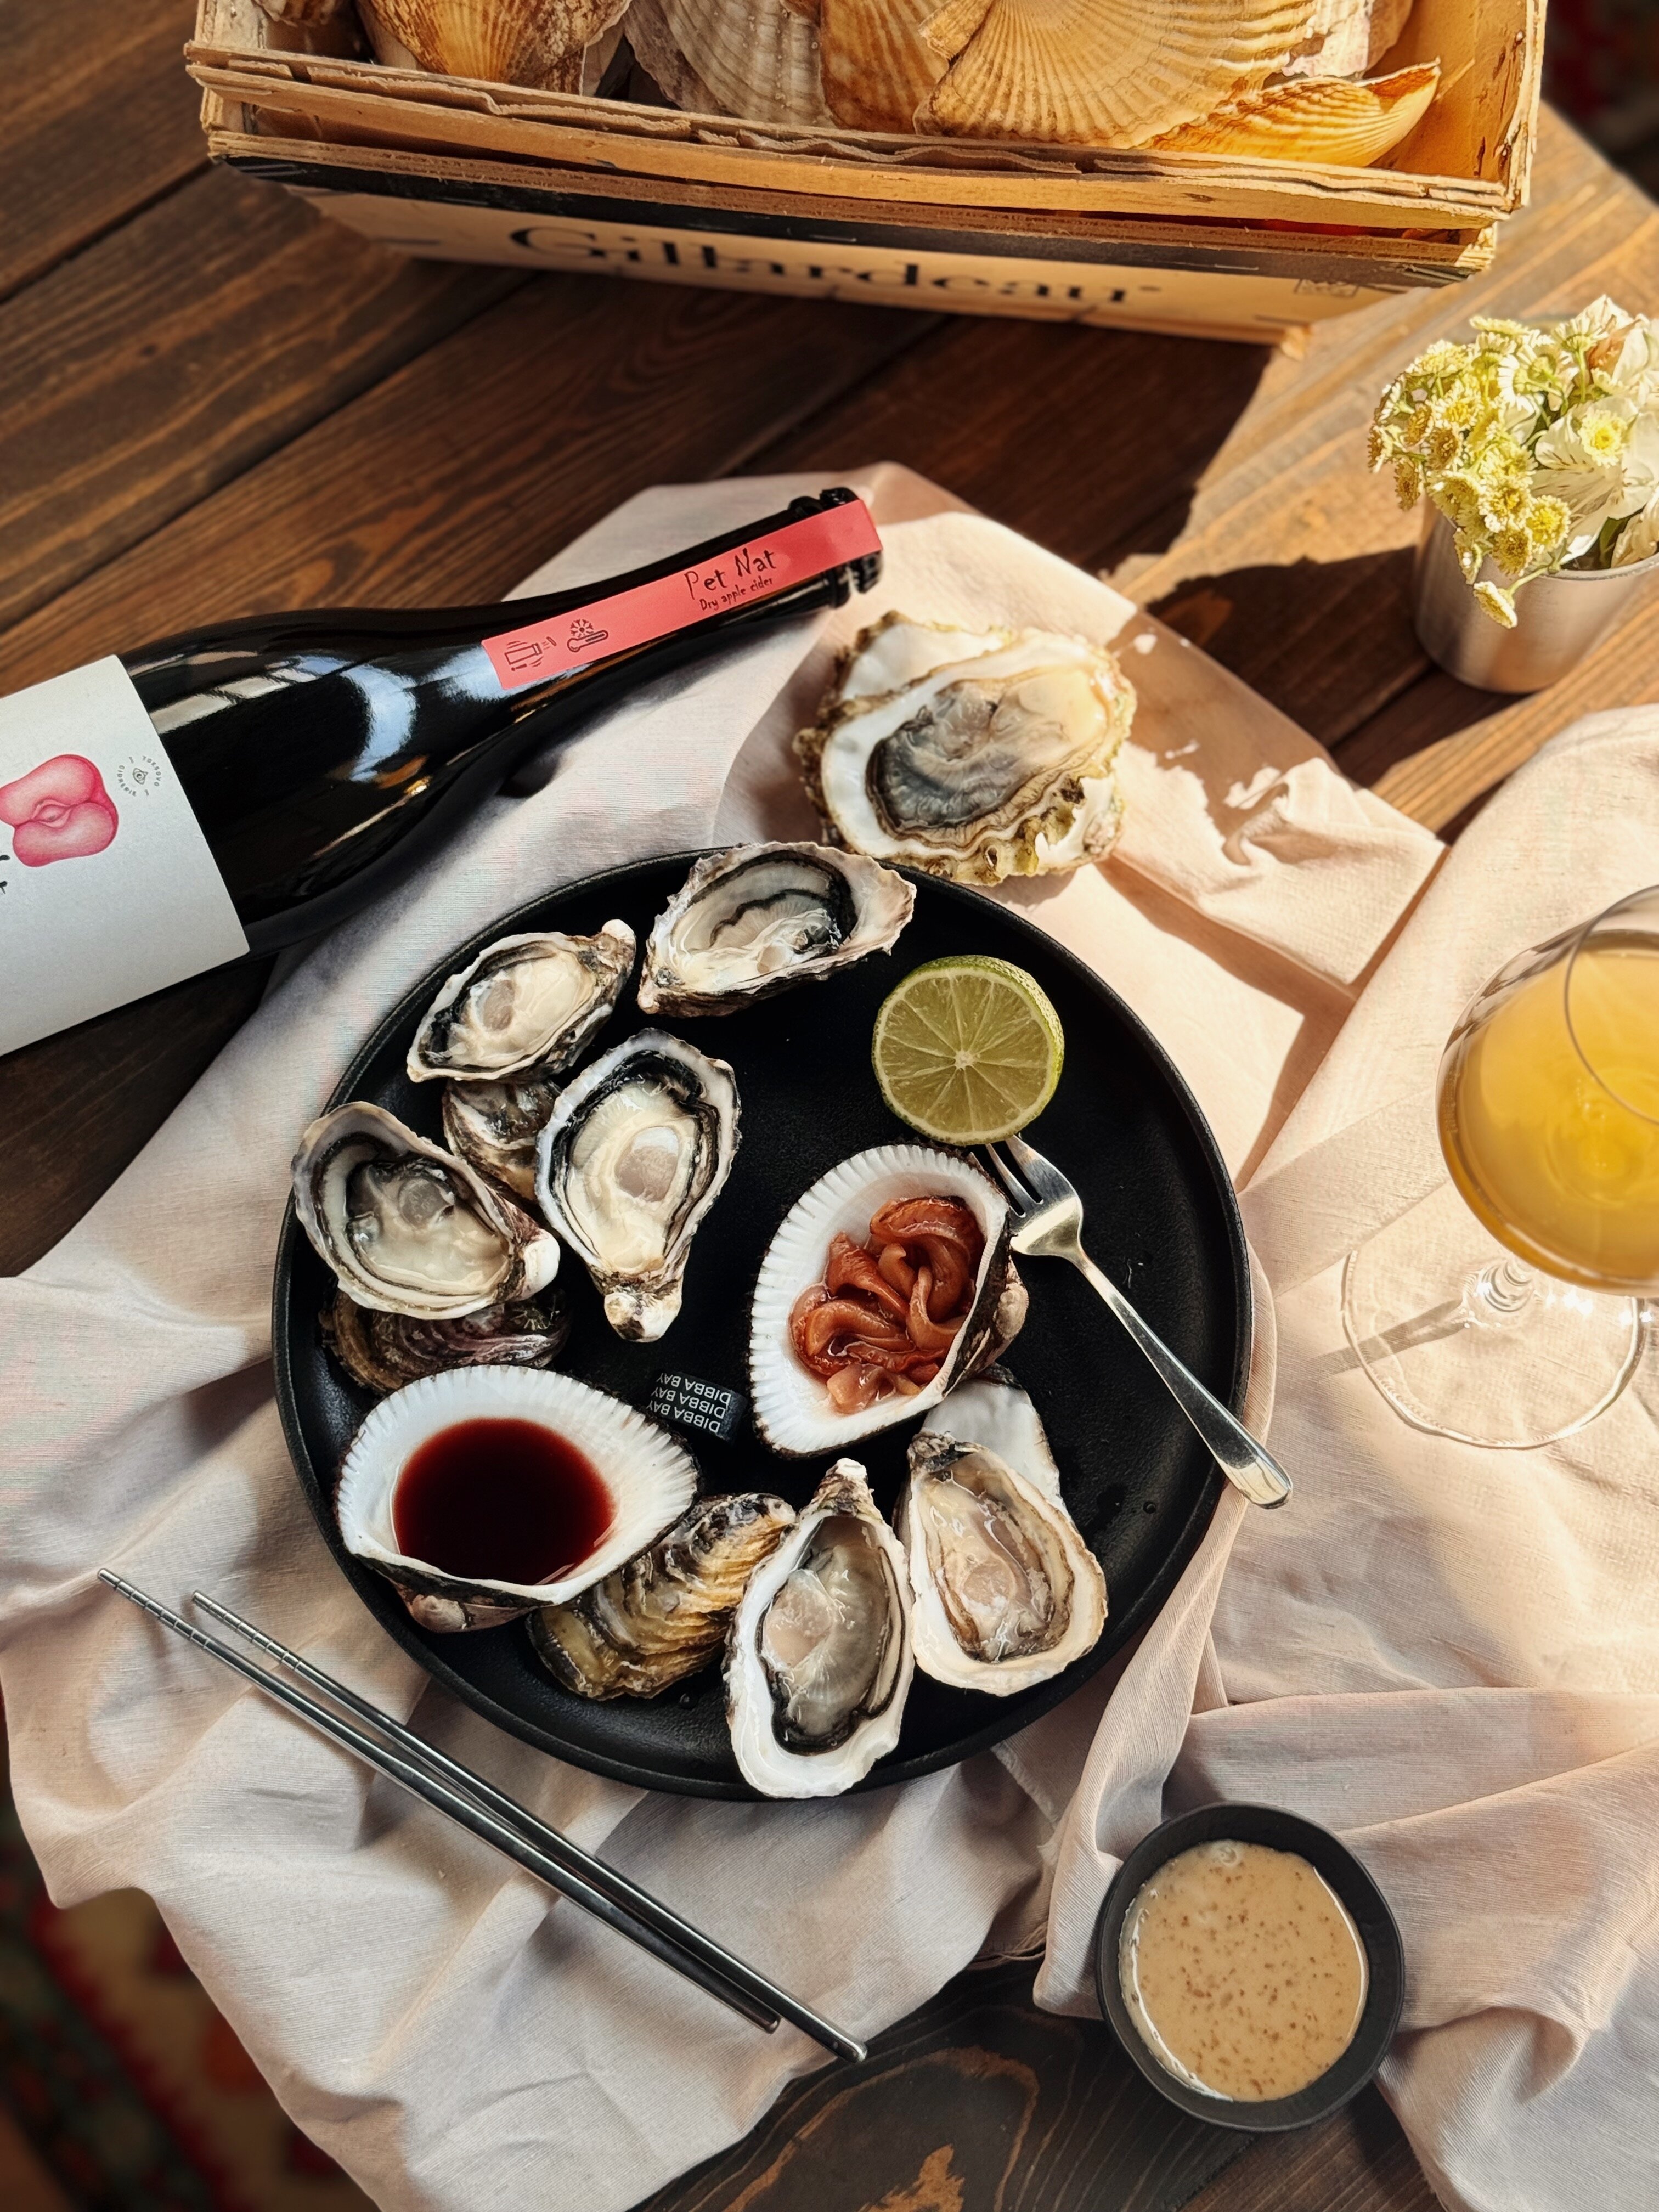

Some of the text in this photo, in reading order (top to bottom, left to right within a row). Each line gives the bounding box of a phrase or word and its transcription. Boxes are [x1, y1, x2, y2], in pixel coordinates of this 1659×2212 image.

[509, 225, 1127, 303] Gillardeau
[684, 548, 777, 600] Pet Nat
[699, 575, 773, 611] Dry apple cider
[651, 1386, 726, 1419] DIBBA BAY
[656, 1373, 732, 1405] DIBBA BAY
[646, 1400, 721, 1434] DIBBA BAY
